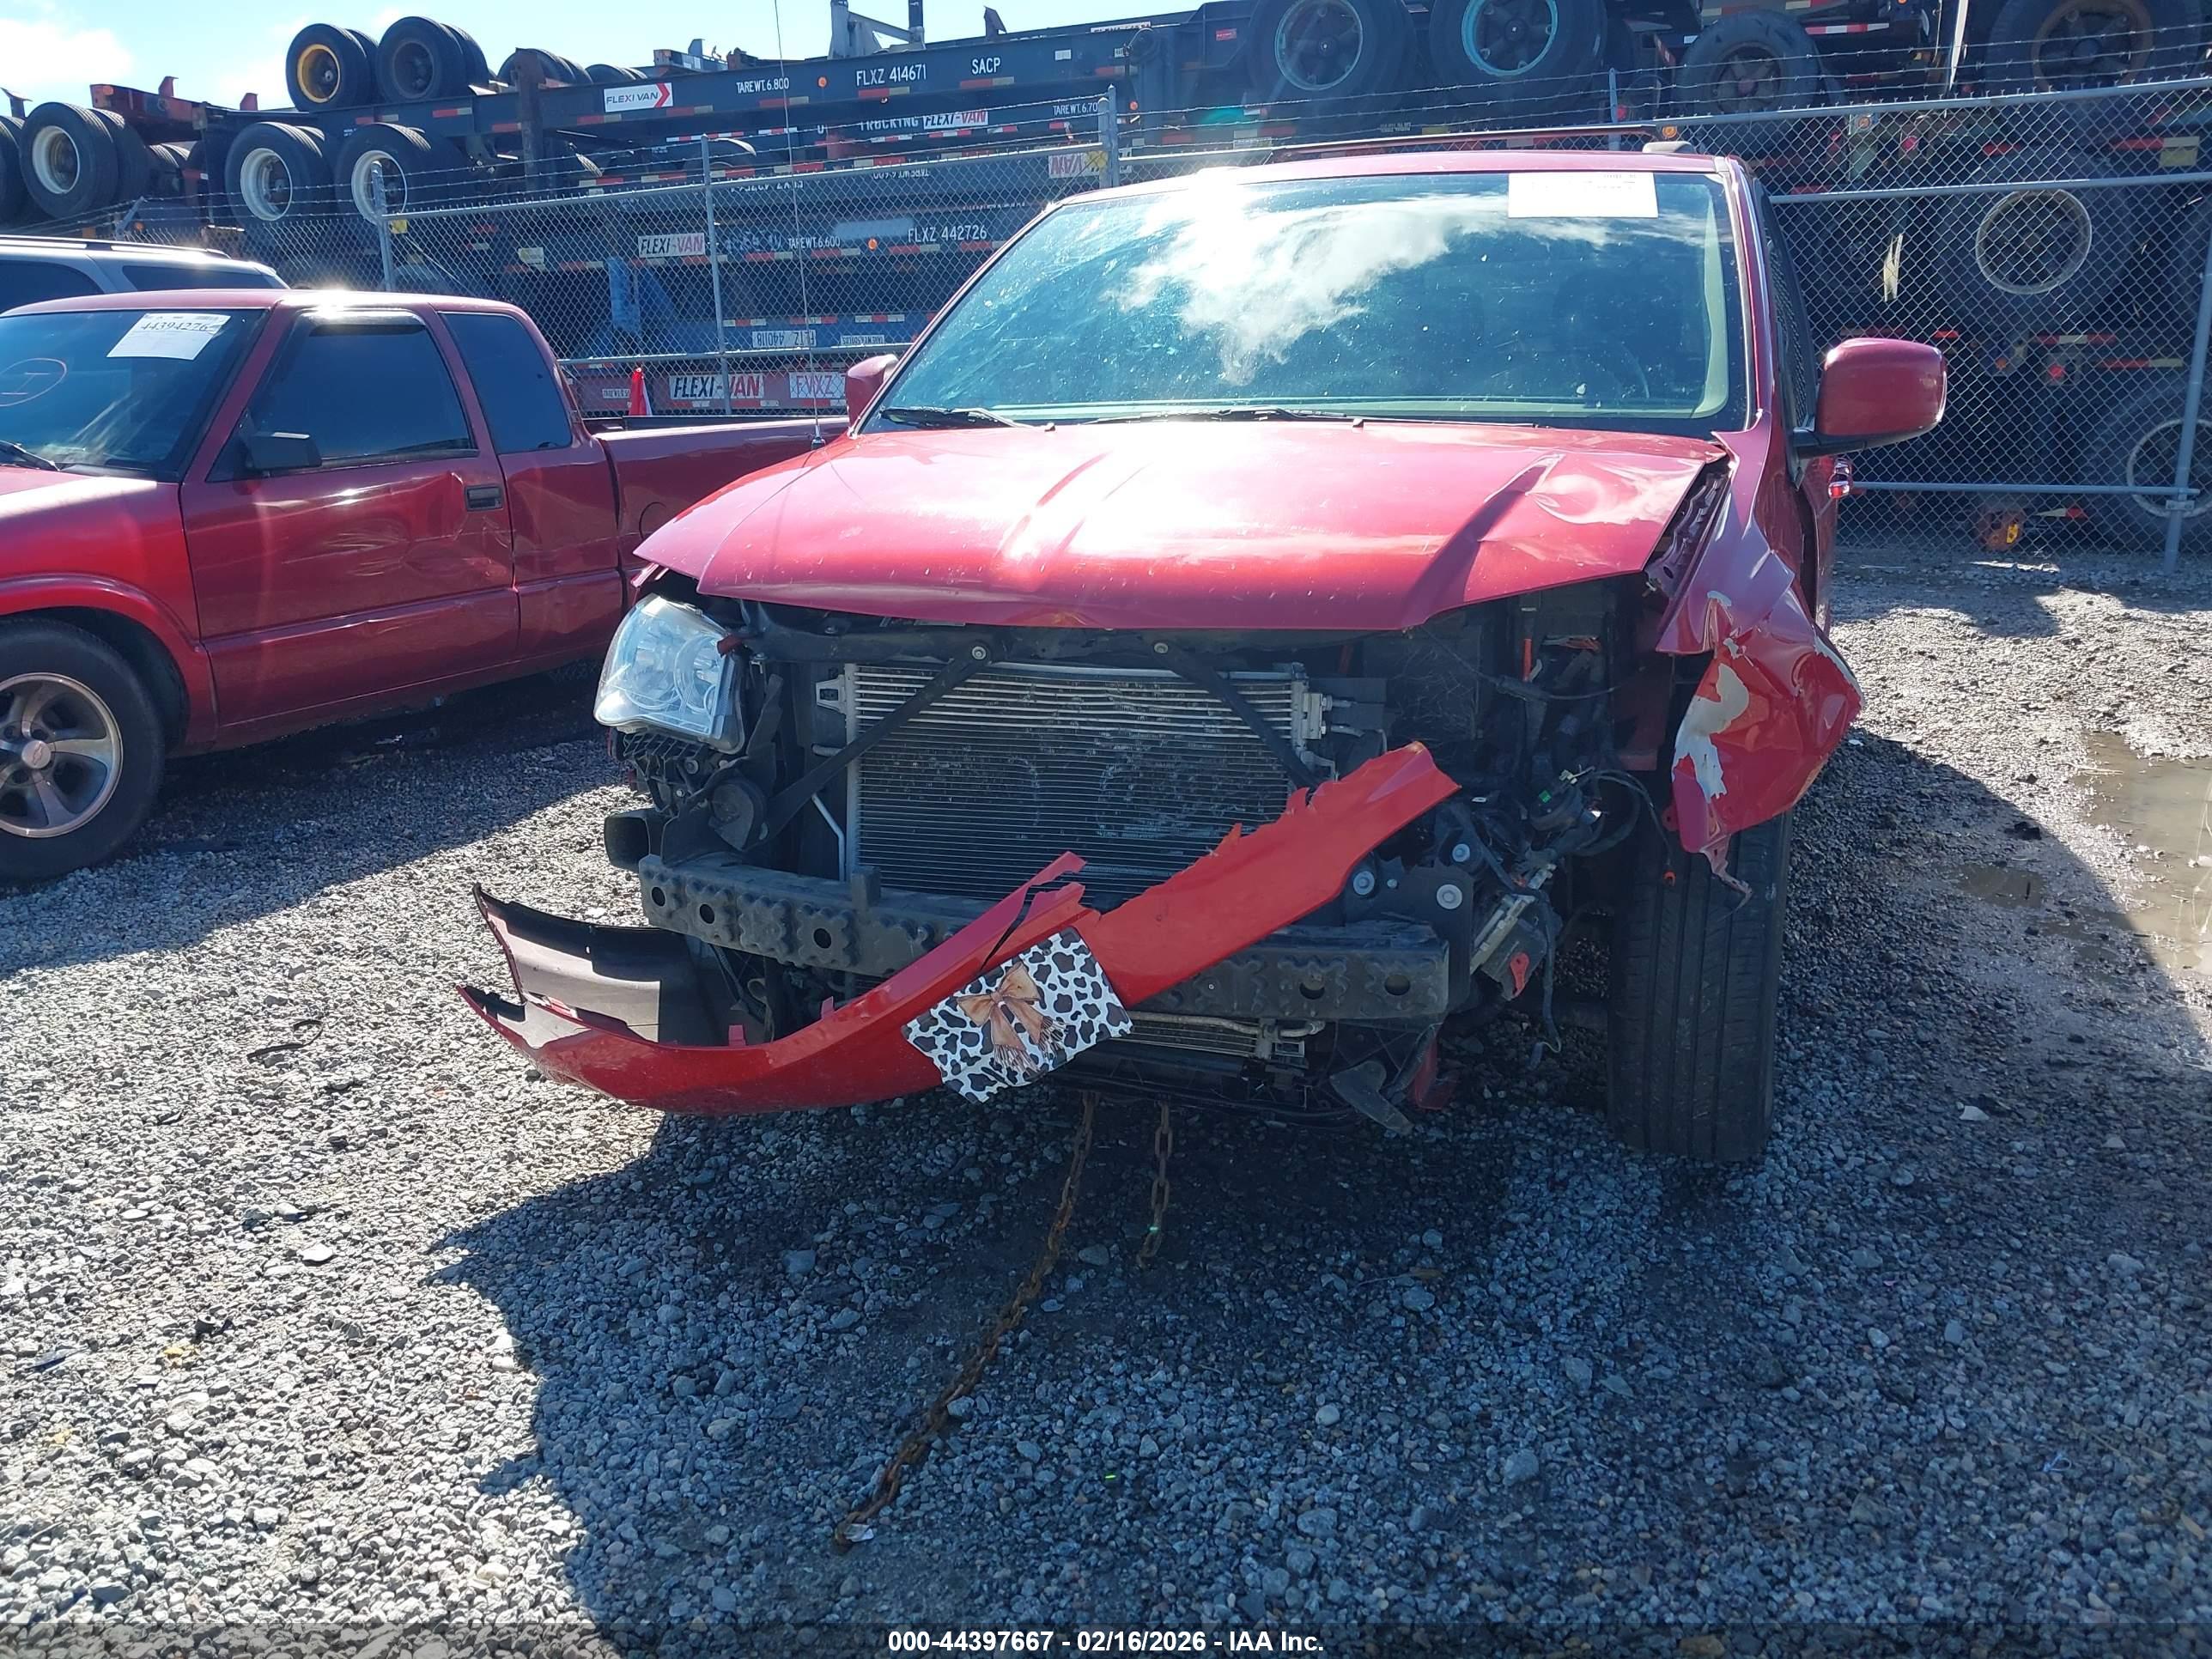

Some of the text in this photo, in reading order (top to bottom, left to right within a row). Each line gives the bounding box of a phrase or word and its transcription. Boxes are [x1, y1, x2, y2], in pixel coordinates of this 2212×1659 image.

[856, 64, 927, 86] FLXZ 414671
[971, 57, 1001, 76] SACP
[606, 91, 658, 104] FLEXI VAN
[908, 224, 988, 243] FLXZ 442726
